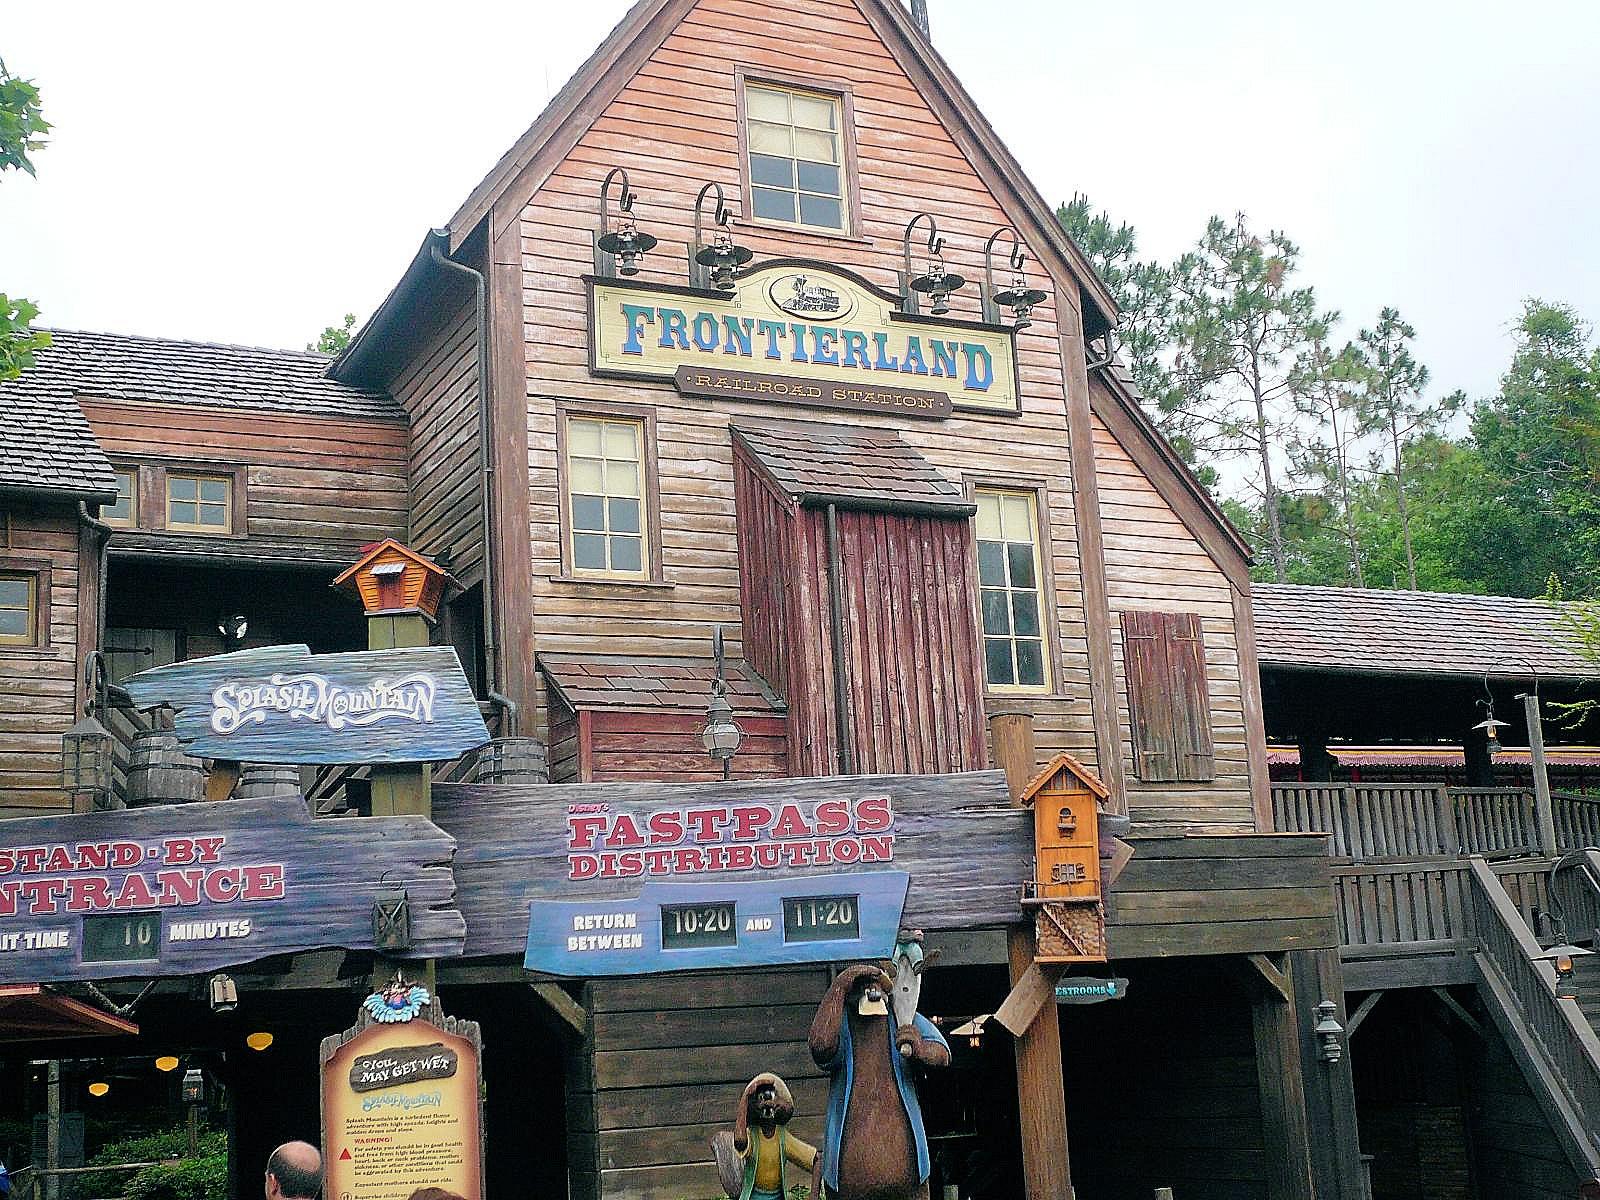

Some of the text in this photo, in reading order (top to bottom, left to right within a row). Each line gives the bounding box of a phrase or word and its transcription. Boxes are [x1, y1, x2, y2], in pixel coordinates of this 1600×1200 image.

[620, 302, 995, 392] FRONTIERLAND
[694, 373, 935, 409] RAILROAD STATION
[211, 673, 434, 735] SPLASH MOUNTAIN
[568, 796, 894, 851] FASTPASS
[568, 834, 894, 881] DISTRIBUTION
[573, 912, 637, 932] RETURN
[673, 906, 731, 934] 10:20
[745, 917, 772, 933] AND
[794, 899, 853, 928] 11:20
[0, 930, 69, 951] IT TIME
[124, 921, 151, 946] 10
[169, 919, 251, 943] MINUTES
[567, 932, 643, 952] BETWEEN
[1055, 985, 1106, 997] ESTROOMS
[360, 1055, 450, 1083] MAY GET WET
[362, 1057, 397, 1071] YOU
